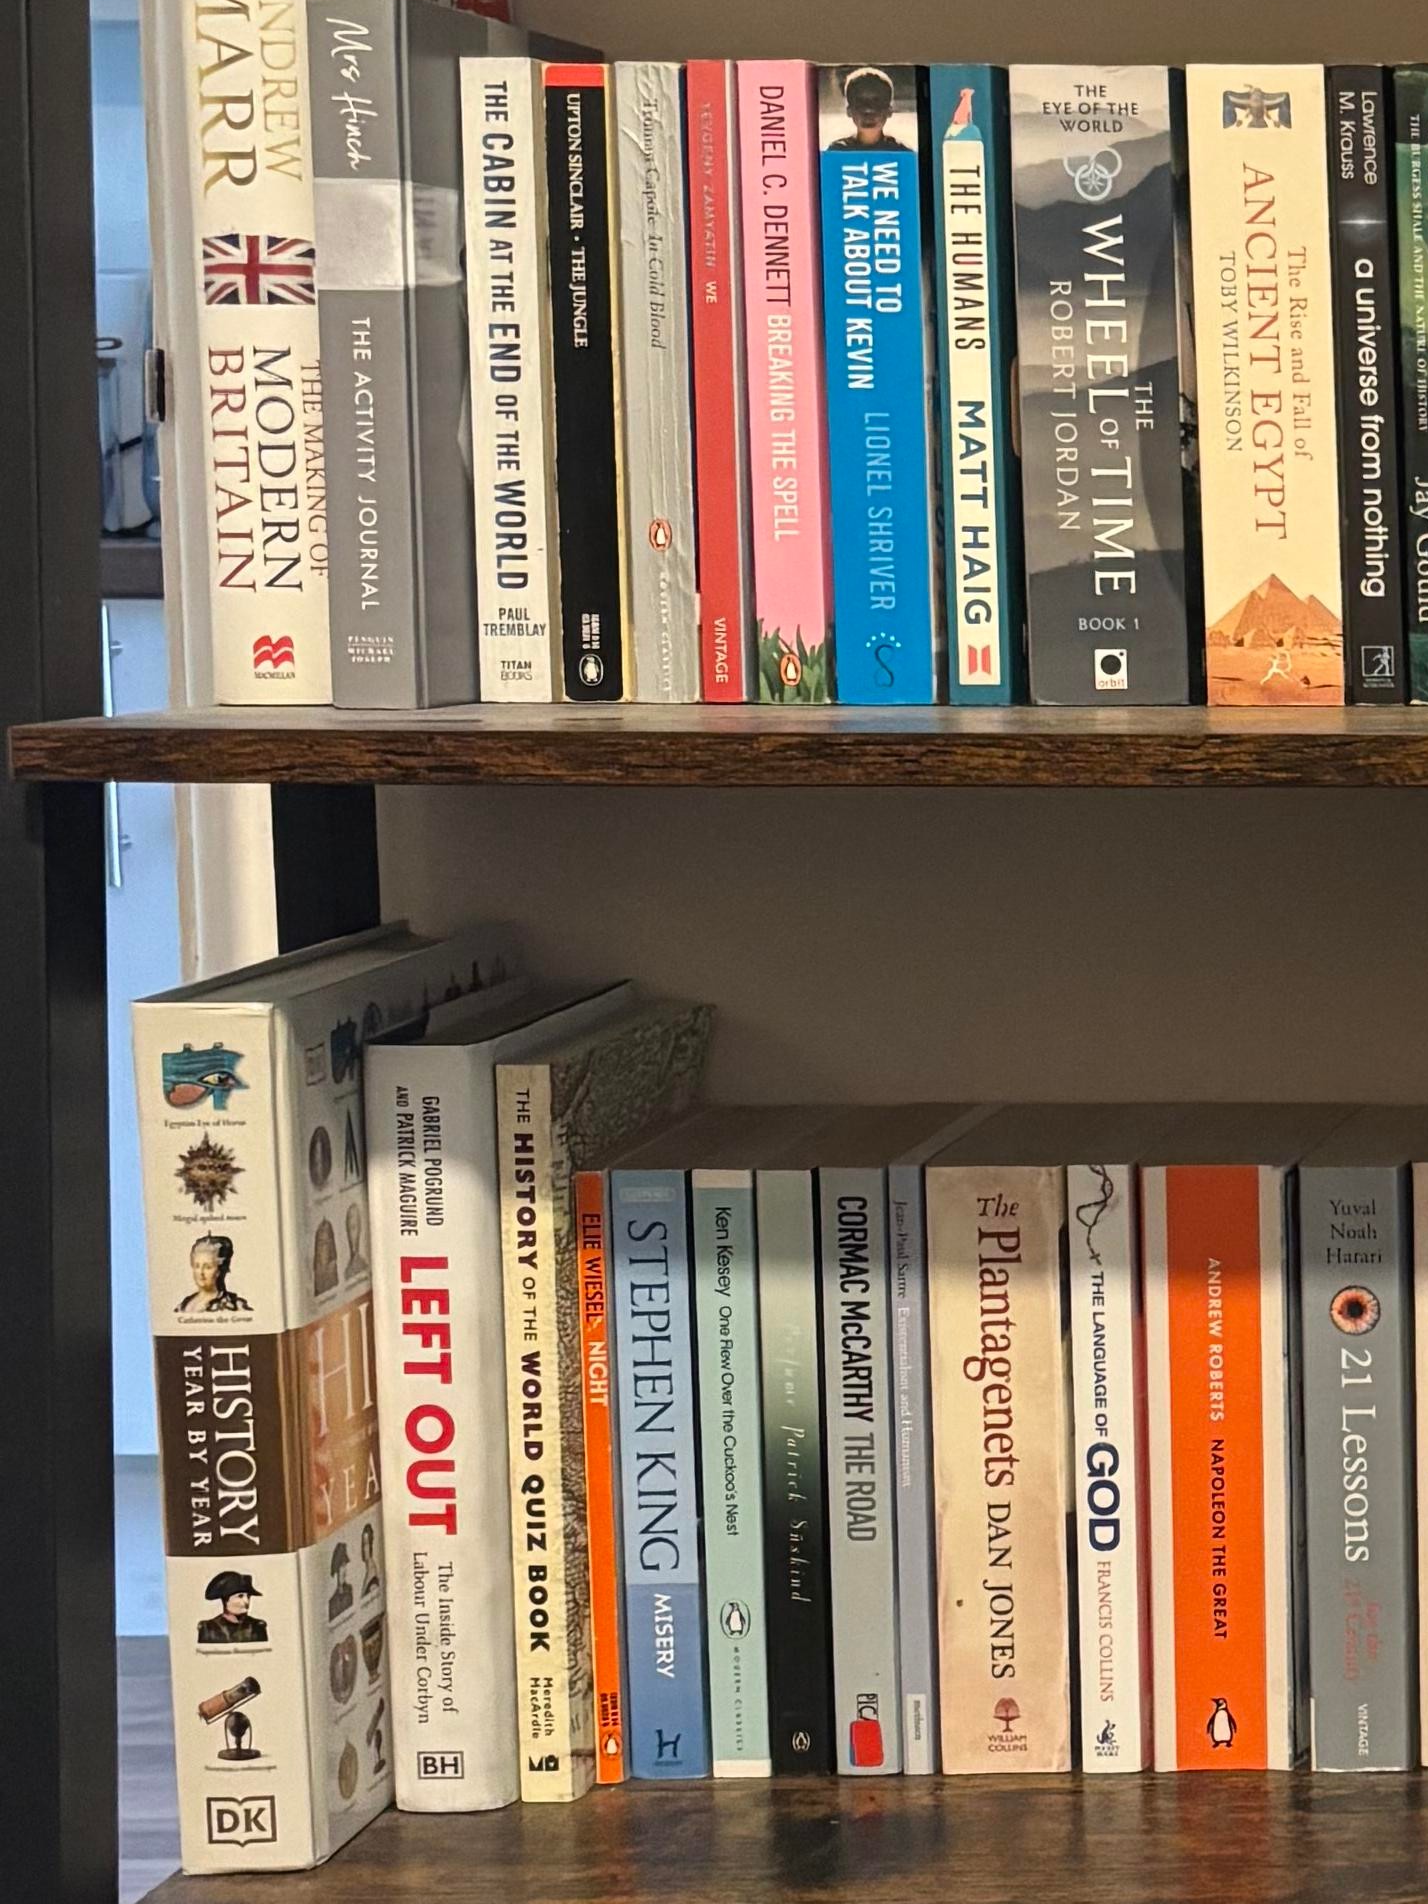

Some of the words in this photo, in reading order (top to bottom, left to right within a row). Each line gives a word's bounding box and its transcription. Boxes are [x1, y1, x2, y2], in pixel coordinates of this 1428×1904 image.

[759, 85, 785, 175] DANIEL
[762, 174, 787, 196] C.
[762, 205, 791, 307] DENNETT
[1242, 162, 1281, 374] ANCIENT
[352, 318, 370, 367] THE
[352, 376, 374, 486] ACTIVITY
[863, 412, 892, 498] LIONEL
[957, 401, 989, 509] MATT
[1252, 388, 1287, 539] EGYPT
[358, 497, 378, 611] JOURNAL
[867, 506, 896, 612] SHRIVER
[962, 526, 993, 626] HAIG
[483, 621, 547, 638] TREMBLAY
[498, 608, 530, 622] PAUL
[399, 1255, 455, 1386] LEFT
[629, 1218, 674, 1434] STEPHEN
[1340, 1348, 1370, 1387] 21
[209, 1344, 260, 1547] HISTORY
[404, 1404, 459, 1536] OUT
[1086, 1442, 1120, 1552] GOD
[1340, 1403, 1371, 1562] Lessons
[637, 1450, 678, 1573] KING
[654, 1594, 674, 1679] MISERY
[218, 1808, 267, 1834] DK
